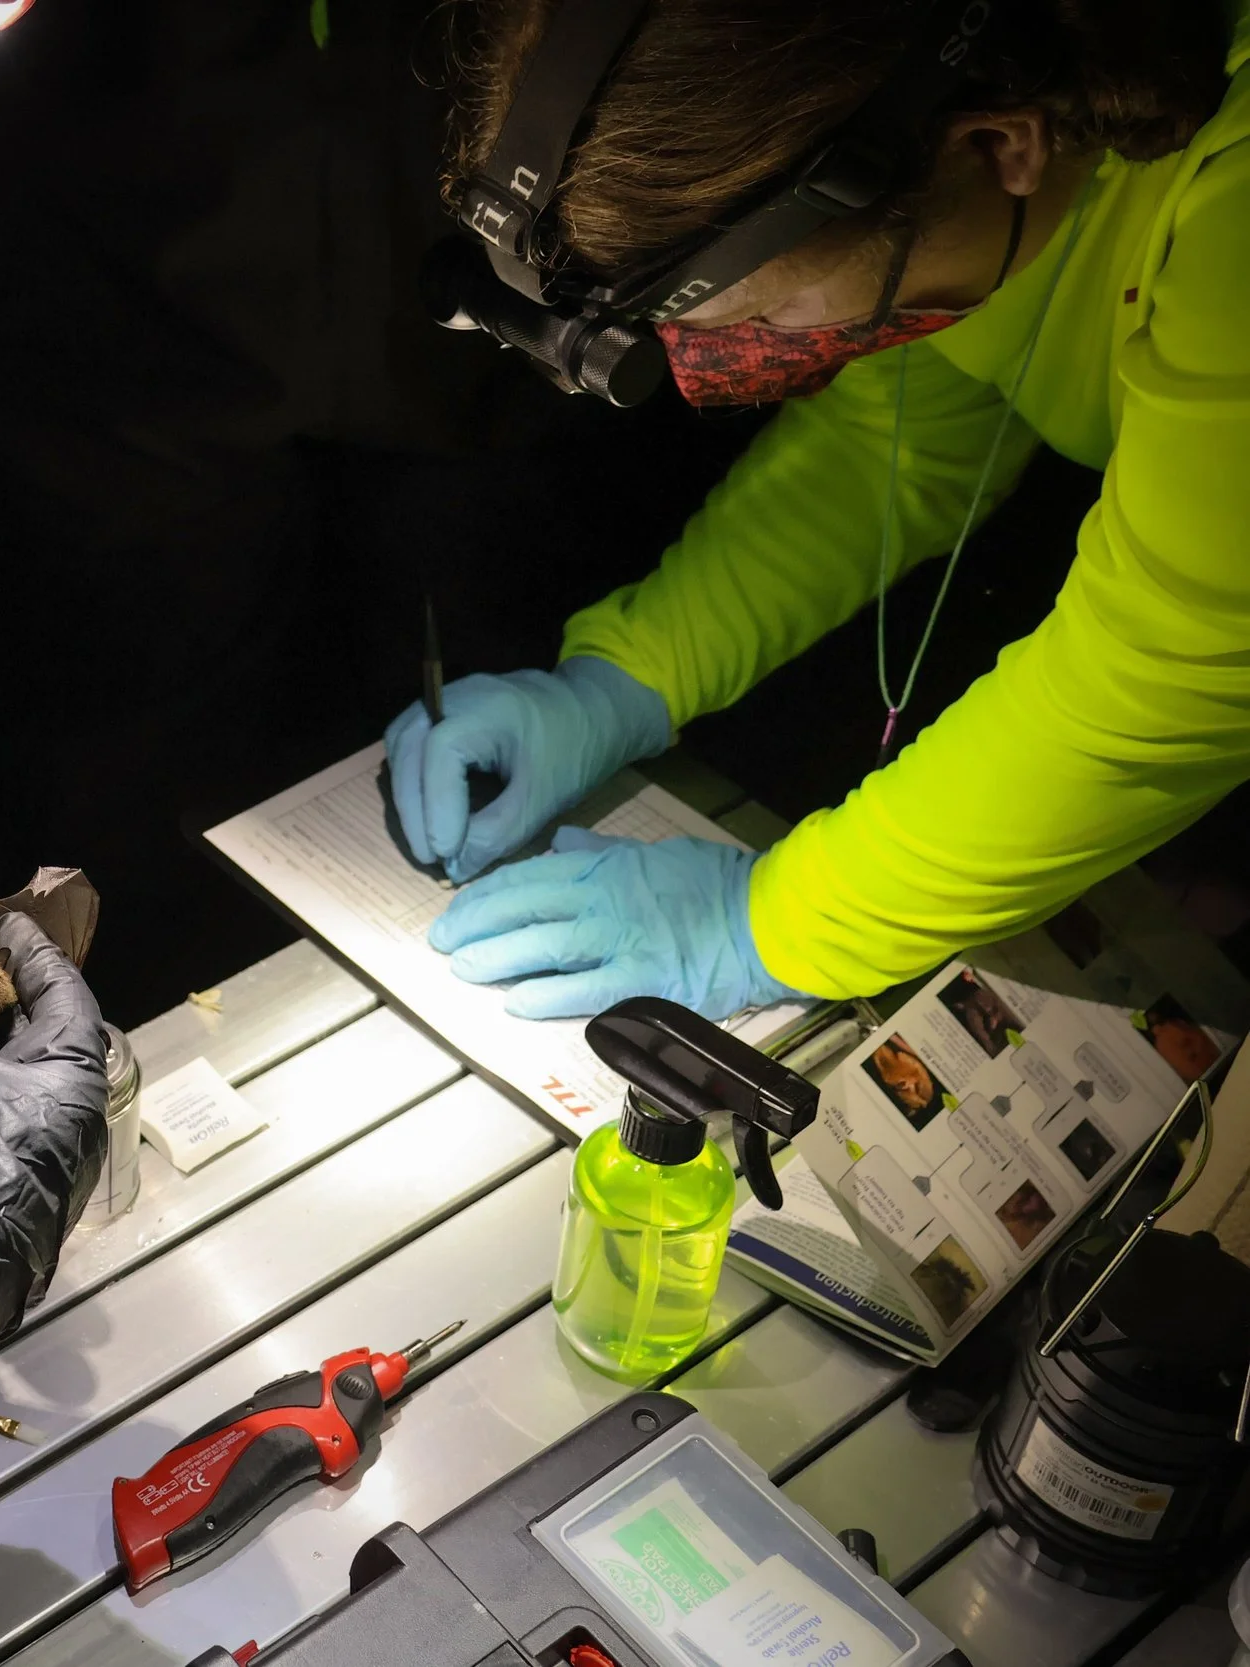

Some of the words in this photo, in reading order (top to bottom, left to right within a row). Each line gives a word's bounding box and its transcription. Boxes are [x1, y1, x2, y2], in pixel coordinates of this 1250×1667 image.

[188, 1116, 230, 1144] ReliOn
[815, 1271, 905, 1328] Introduction
[643, 1543, 670, 1570] PAD
[785, 1615, 822, 1644] Alcohol
[762, 1639, 791, 1658] Swab
[787, 1633, 821, 1657] Sterile
